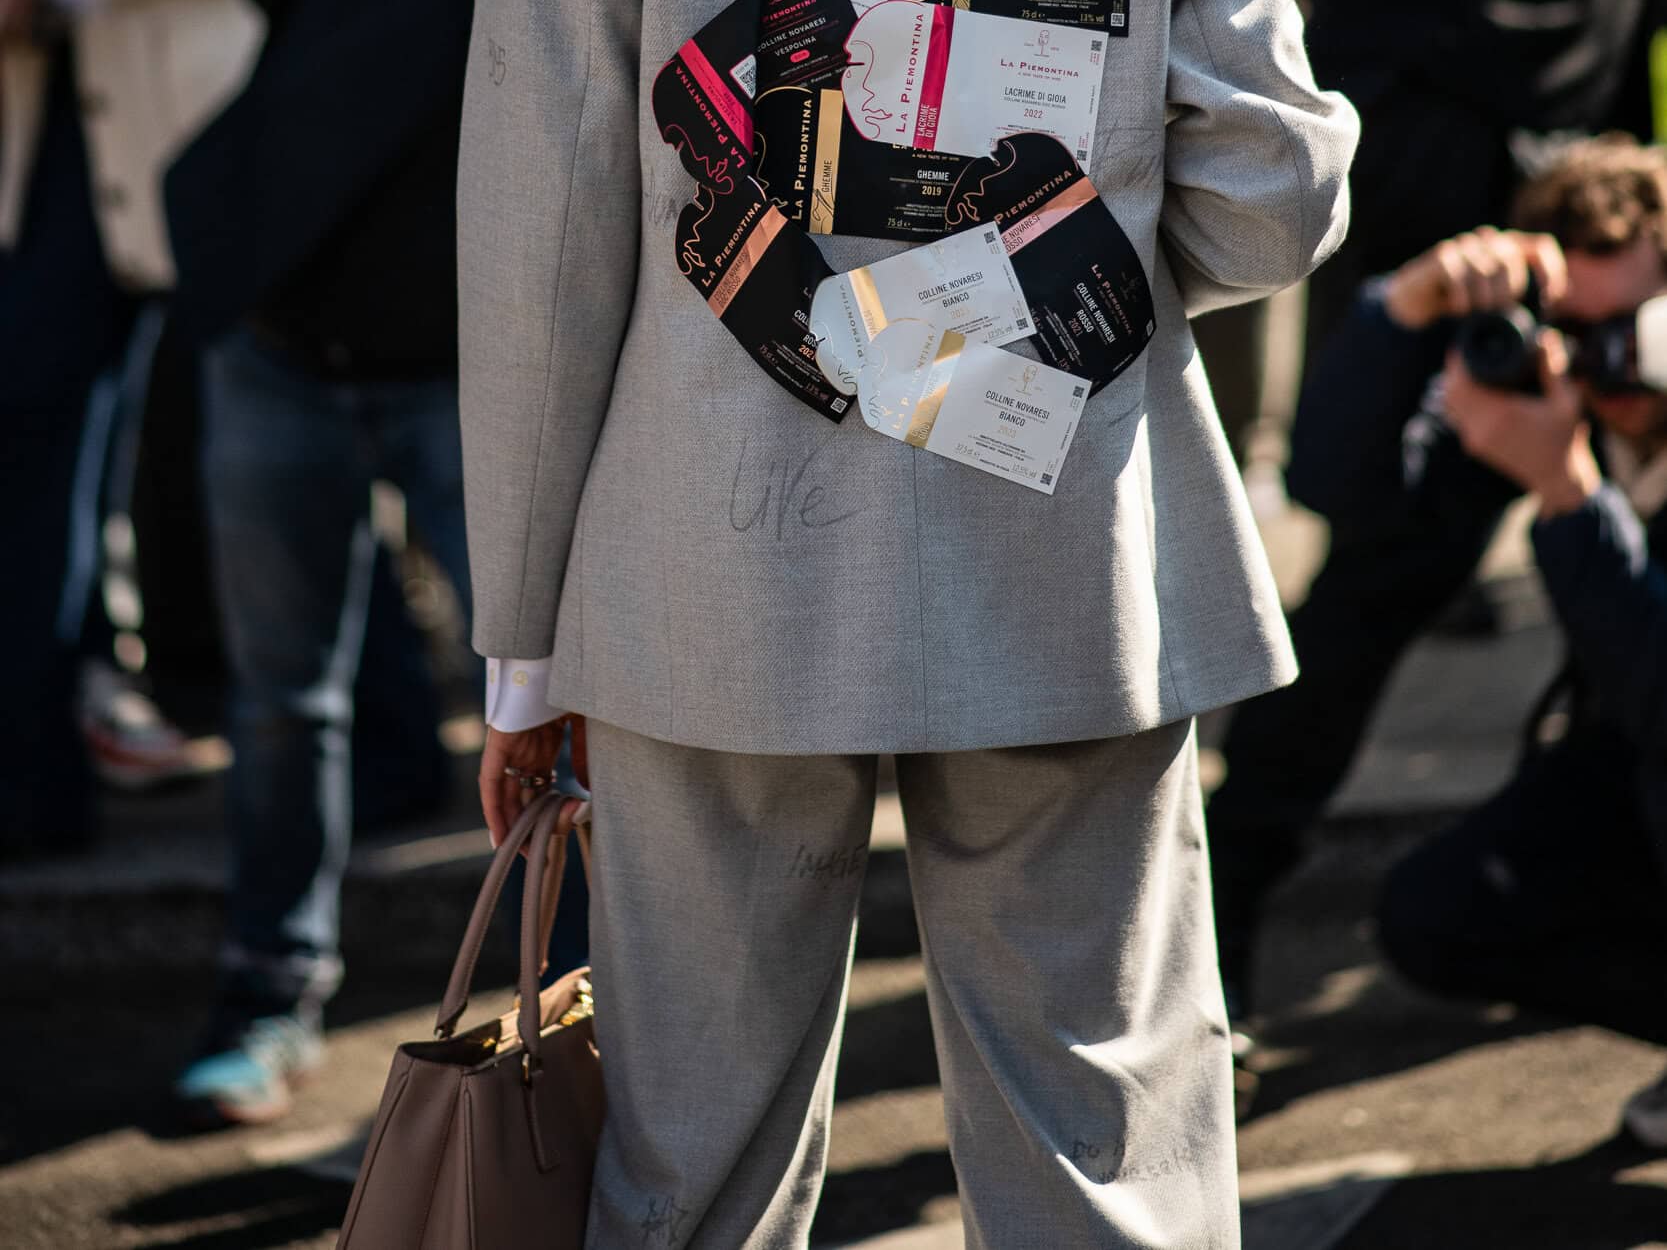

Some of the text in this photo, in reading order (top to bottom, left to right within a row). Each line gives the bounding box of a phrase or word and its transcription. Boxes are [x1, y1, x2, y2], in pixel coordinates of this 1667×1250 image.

[788, 17, 826, 36] NOVARESI
[775, 36, 817, 56] VESPOLINA
[895, 13, 924, 134] LA PIEMONTINA
[1000, 58, 1079, 78] LA PIEMONTINA
[676, 66, 728, 145] PIEMONTINA
[1004, 86, 1066, 103] LACRIME DI GIOIA
[916, 103, 930, 137] LACRIME
[926, 106, 937, 126] GIOIA
[1023, 109, 1043, 119] 2022
[731, 147, 746, 168] LA
[791, 99, 812, 221] LA PIEMONTINA
[822, 159, 833, 193] GHEMME
[917, 170, 950, 181] GHEMME
[921, 185, 942, 196] 2019
[994, 170, 1073, 225] PIEMONTINA
[1009, 213, 1041, 240] NOVARESI
[701, 201, 762, 287] LA PIEMONTINA
[1006, 236, 1024, 253] OSSO
[918, 284, 949, 301] COLLINE
[949, 272, 983, 290] NOVARESI
[942, 292, 970, 308] BIANCO
[1091, 263, 1103, 279] LA
[1102, 280, 1132, 335] PIEMONTINA
[1076, 282, 1116, 343] COLLINE NOVARESI
[1077, 309, 1095, 333] ROSSO
[1068, 317, 1083, 337] 2021
[986, 390, 1015, 407] COLLINE
[1015, 400, 1050, 419] NOVARESI
[999, 411, 1025, 427] BIANCO
